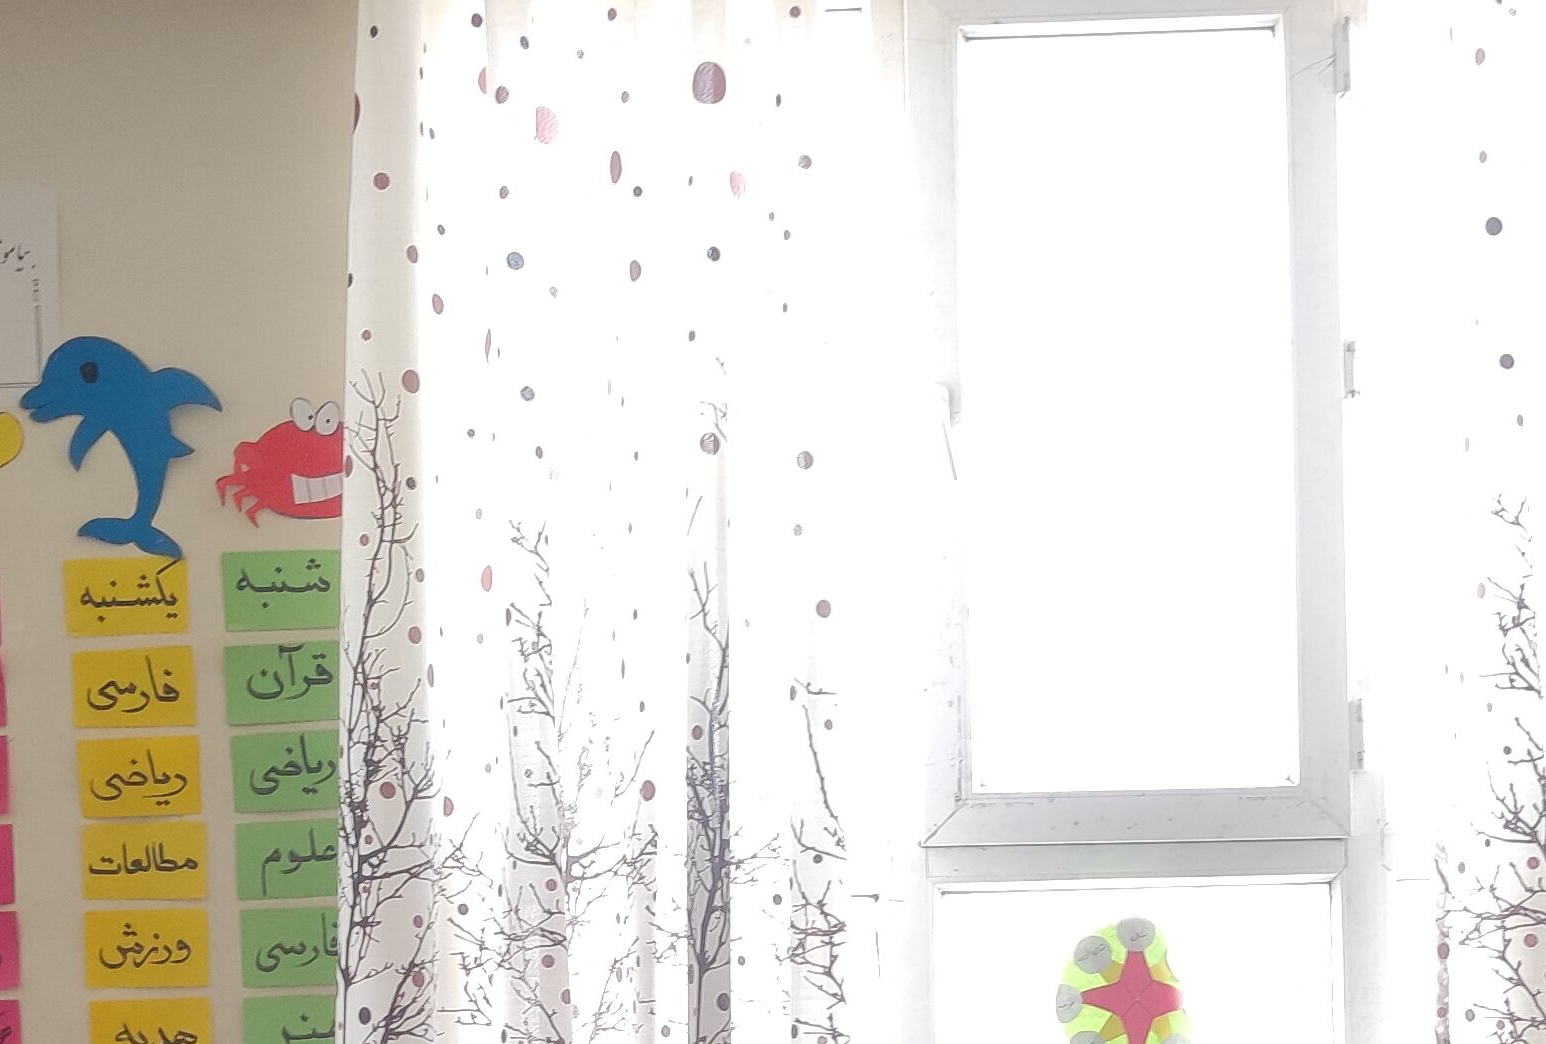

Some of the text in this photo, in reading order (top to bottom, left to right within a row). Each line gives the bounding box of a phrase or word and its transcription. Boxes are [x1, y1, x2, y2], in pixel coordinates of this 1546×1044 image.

[80, 560, 179, 622] یکشنبه
[236, 558, 331, 609] شنبه
[87, 655, 180, 713] فارسی
[247, 643, 334, 700] قرآن
[90, 749, 187, 806] ریاضی
[250, 732, 336, 796] ریاضی
[89, 841, 198, 875] مطالعات
[262, 828, 337, 896] علوم
[100, 922, 191, 970] ورزش
